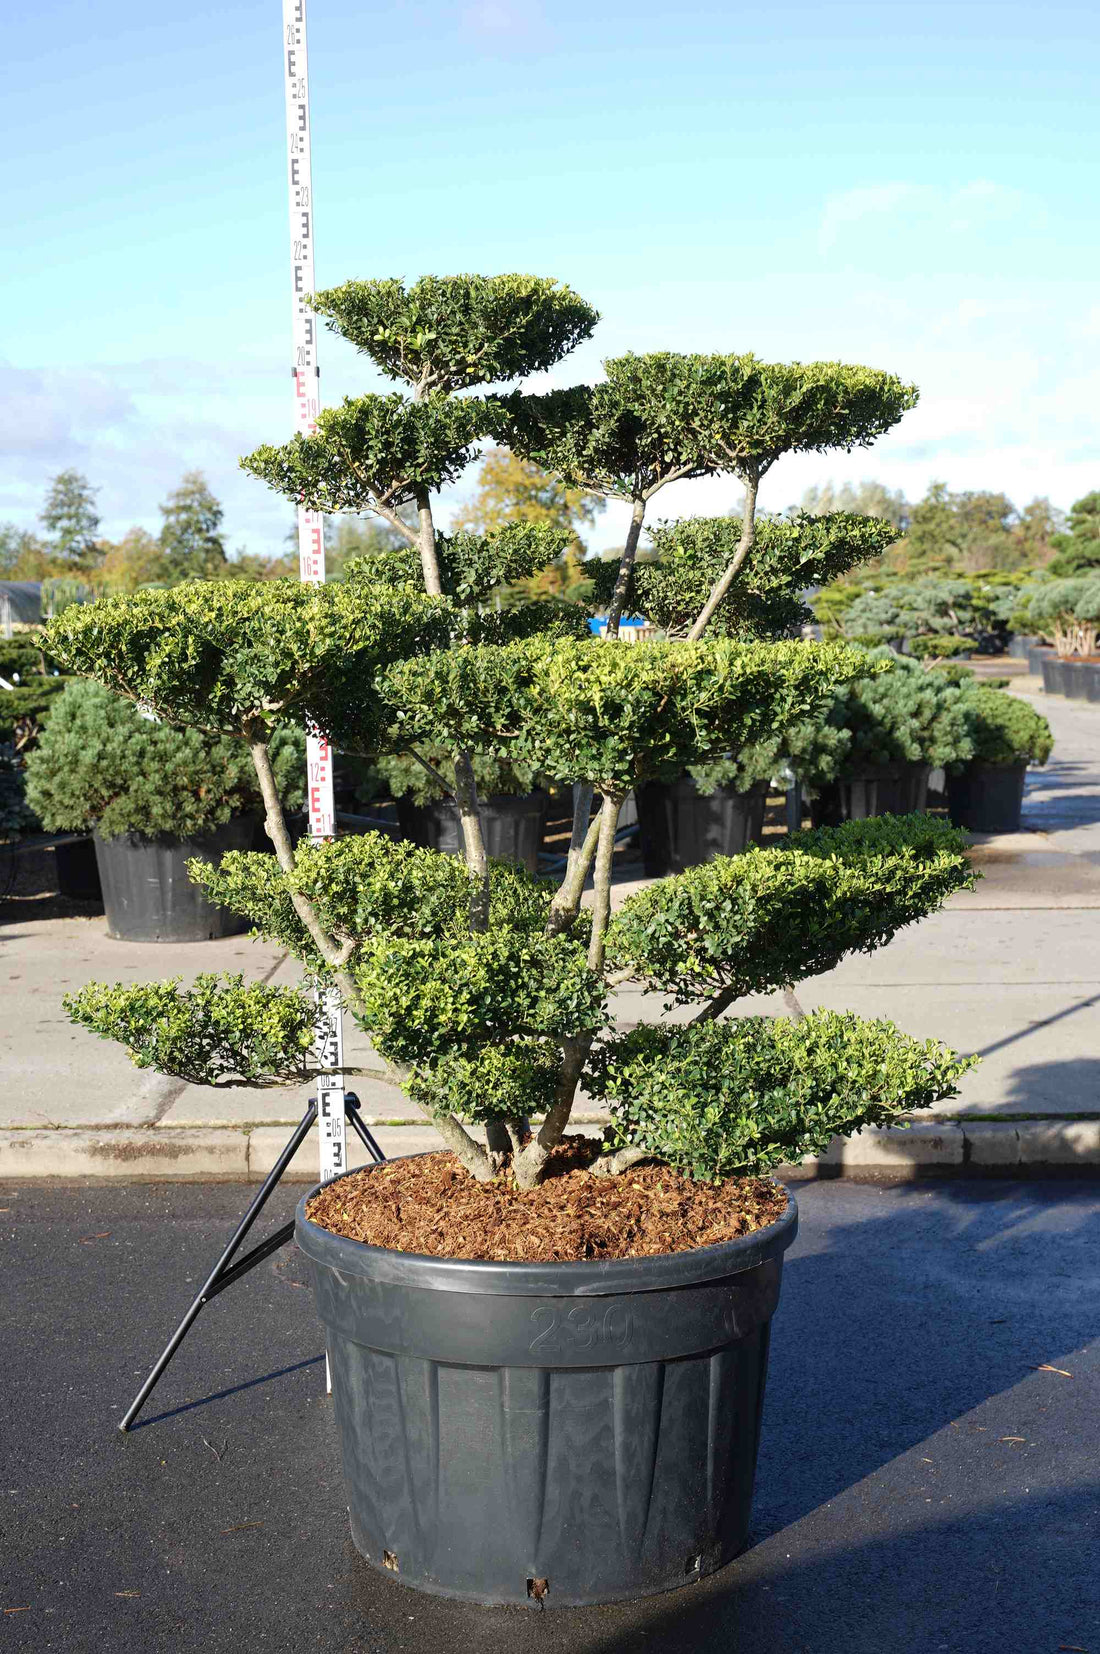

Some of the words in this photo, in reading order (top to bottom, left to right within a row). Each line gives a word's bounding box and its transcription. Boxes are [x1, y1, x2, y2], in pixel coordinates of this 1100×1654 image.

[287, 24, 295, 45] 26
[297, 78, 306, 98] 25
[291, 133, 299, 153] 24
[301, 187, 309, 206] 23
[294, 241, 302, 260] 22
[297, 346, 306, 366] 20
[307, 399, 316, 418] 19
[303, 557, 311, 576] 16
[310, 762, 320, 782] 12
[322, 814, 332, 833] 11
[332, 1118, 341, 1138] 05
[528, 1303, 634, 1353] 230
